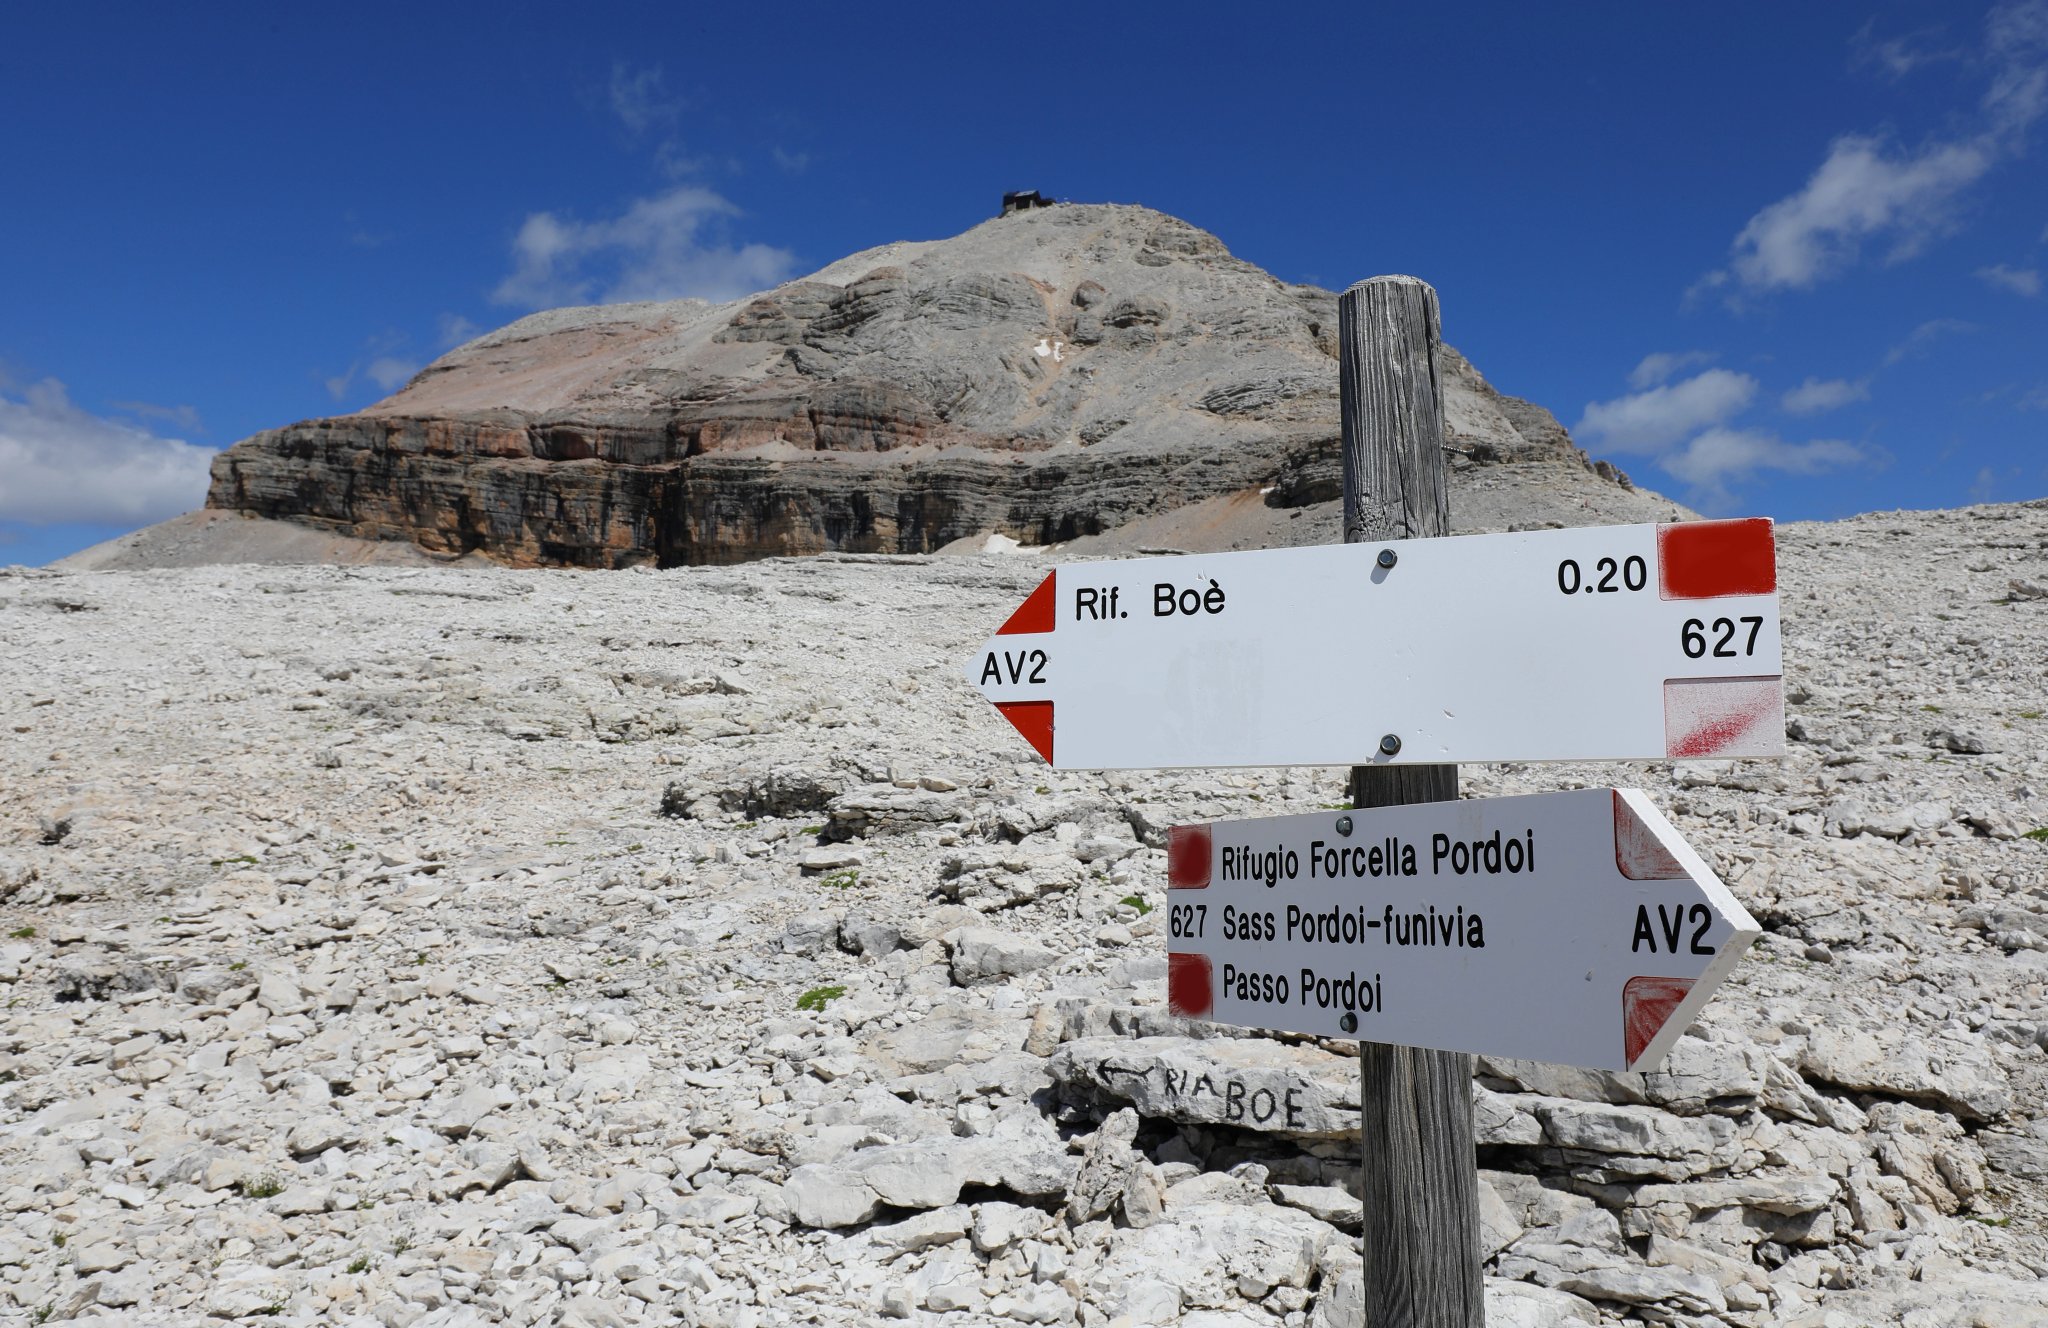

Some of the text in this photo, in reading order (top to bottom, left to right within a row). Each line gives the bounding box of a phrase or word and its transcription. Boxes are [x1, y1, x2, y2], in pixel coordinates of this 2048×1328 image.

[1558, 556, 1647, 595] 0.20
[1077, 578, 1226, 621] Rif. Boè
[1682, 616, 1764, 659] 627
[980, 649, 1048, 686] AV2
[1222, 829, 1535, 889] Rifugio Forcella Pordoi
[1170, 904, 1208, 939] 627
[1223, 904, 1486, 949] Sass Pordoi-funivia
[1631, 903, 1716, 956] AV2
[1223, 963, 1383, 1013] Passo Pordoi
